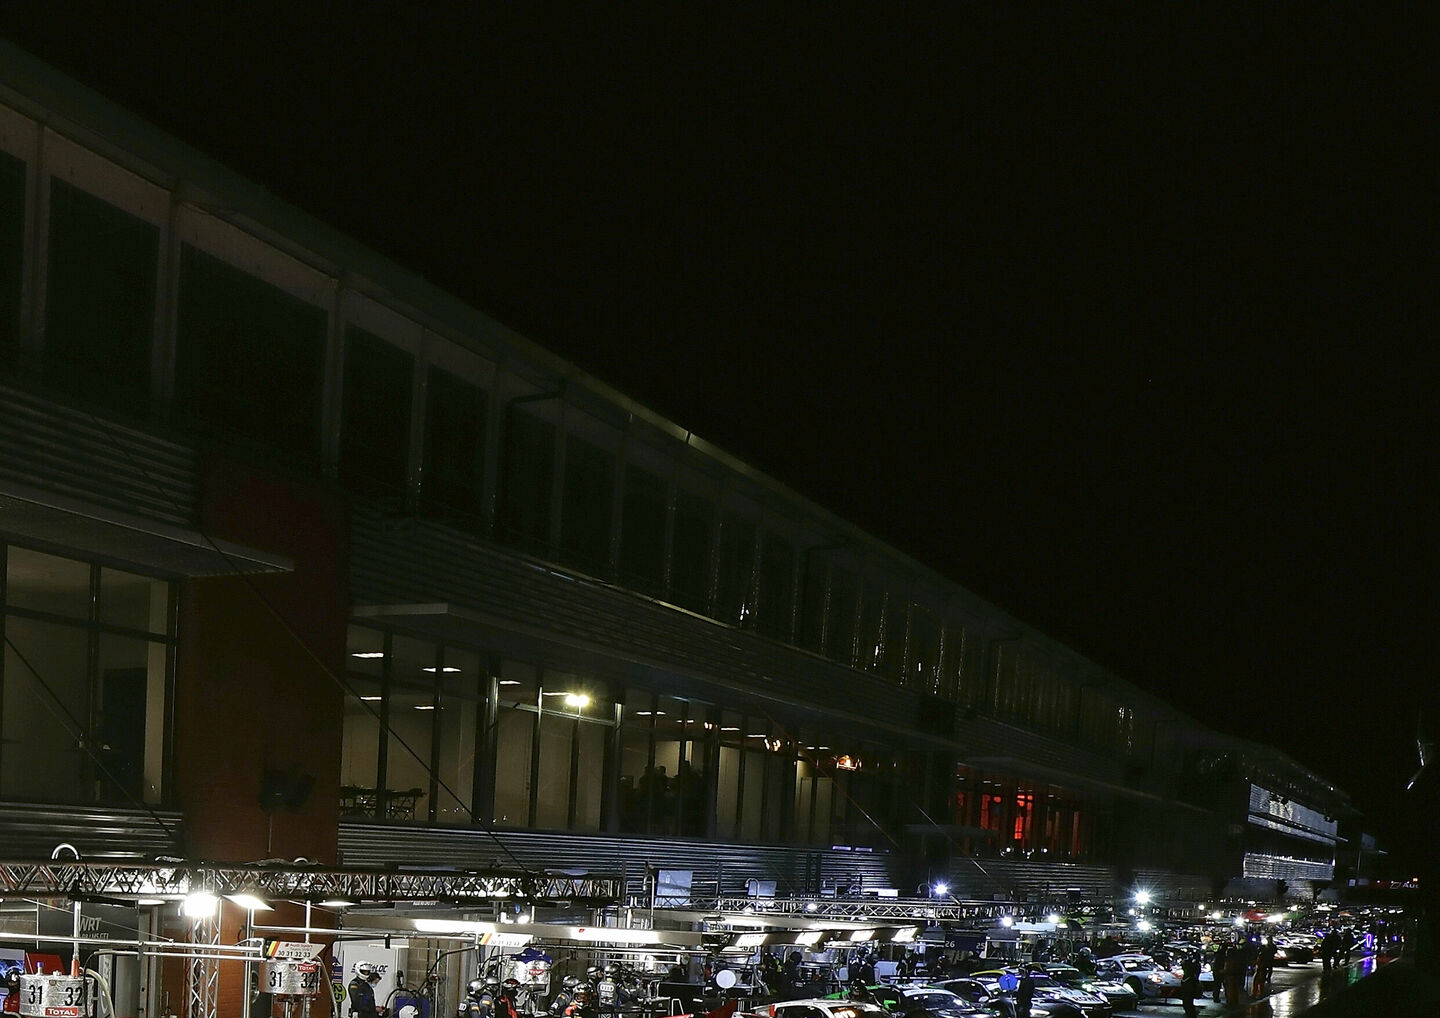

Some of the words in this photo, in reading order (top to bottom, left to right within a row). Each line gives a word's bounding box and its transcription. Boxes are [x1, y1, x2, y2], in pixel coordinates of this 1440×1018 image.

[299, 964, 316, 972] TOTAL
[269, 971, 283, 988] 31
[300, 972, 316, 989] 32
[29, 985, 43, 1005] 31
[65, 987, 83, 1007] 32
[47, 1008, 76, 1016] TOTAL
